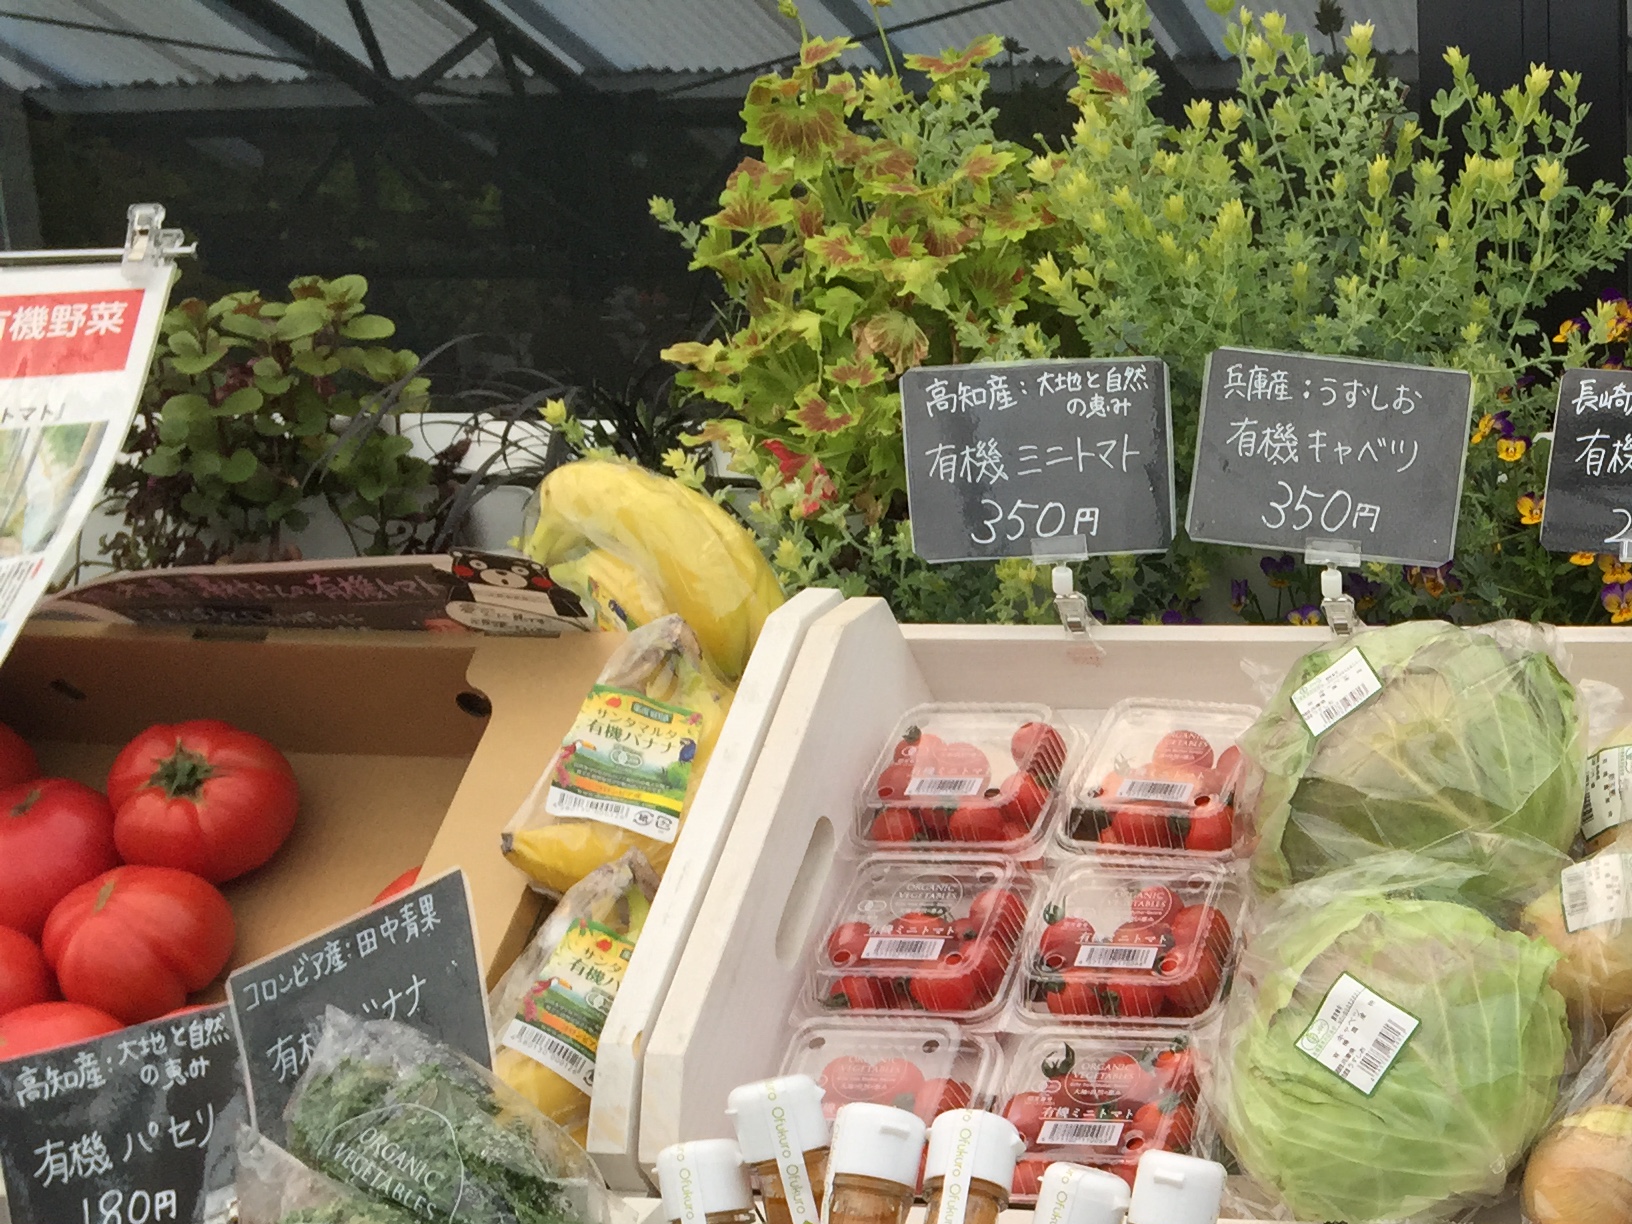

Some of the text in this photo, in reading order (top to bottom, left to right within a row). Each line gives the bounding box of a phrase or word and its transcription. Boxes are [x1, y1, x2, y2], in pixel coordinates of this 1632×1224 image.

[970, 499, 1099, 544] 350円
[1261, 481, 1380, 534] 350円
[587, 720, 677, 753] 有機バナナ
[772, 1106, 791, 1158] Ofukuro
[952, 1128, 972, 1178] Ofukuro
[334, 1142, 436, 1221] VEGETABLES
[359, 1126, 445, 1192] ORGANIC
[680, 1167, 694, 1220] Ofukuro
[786, 1164, 805, 1214] Ofukuro
